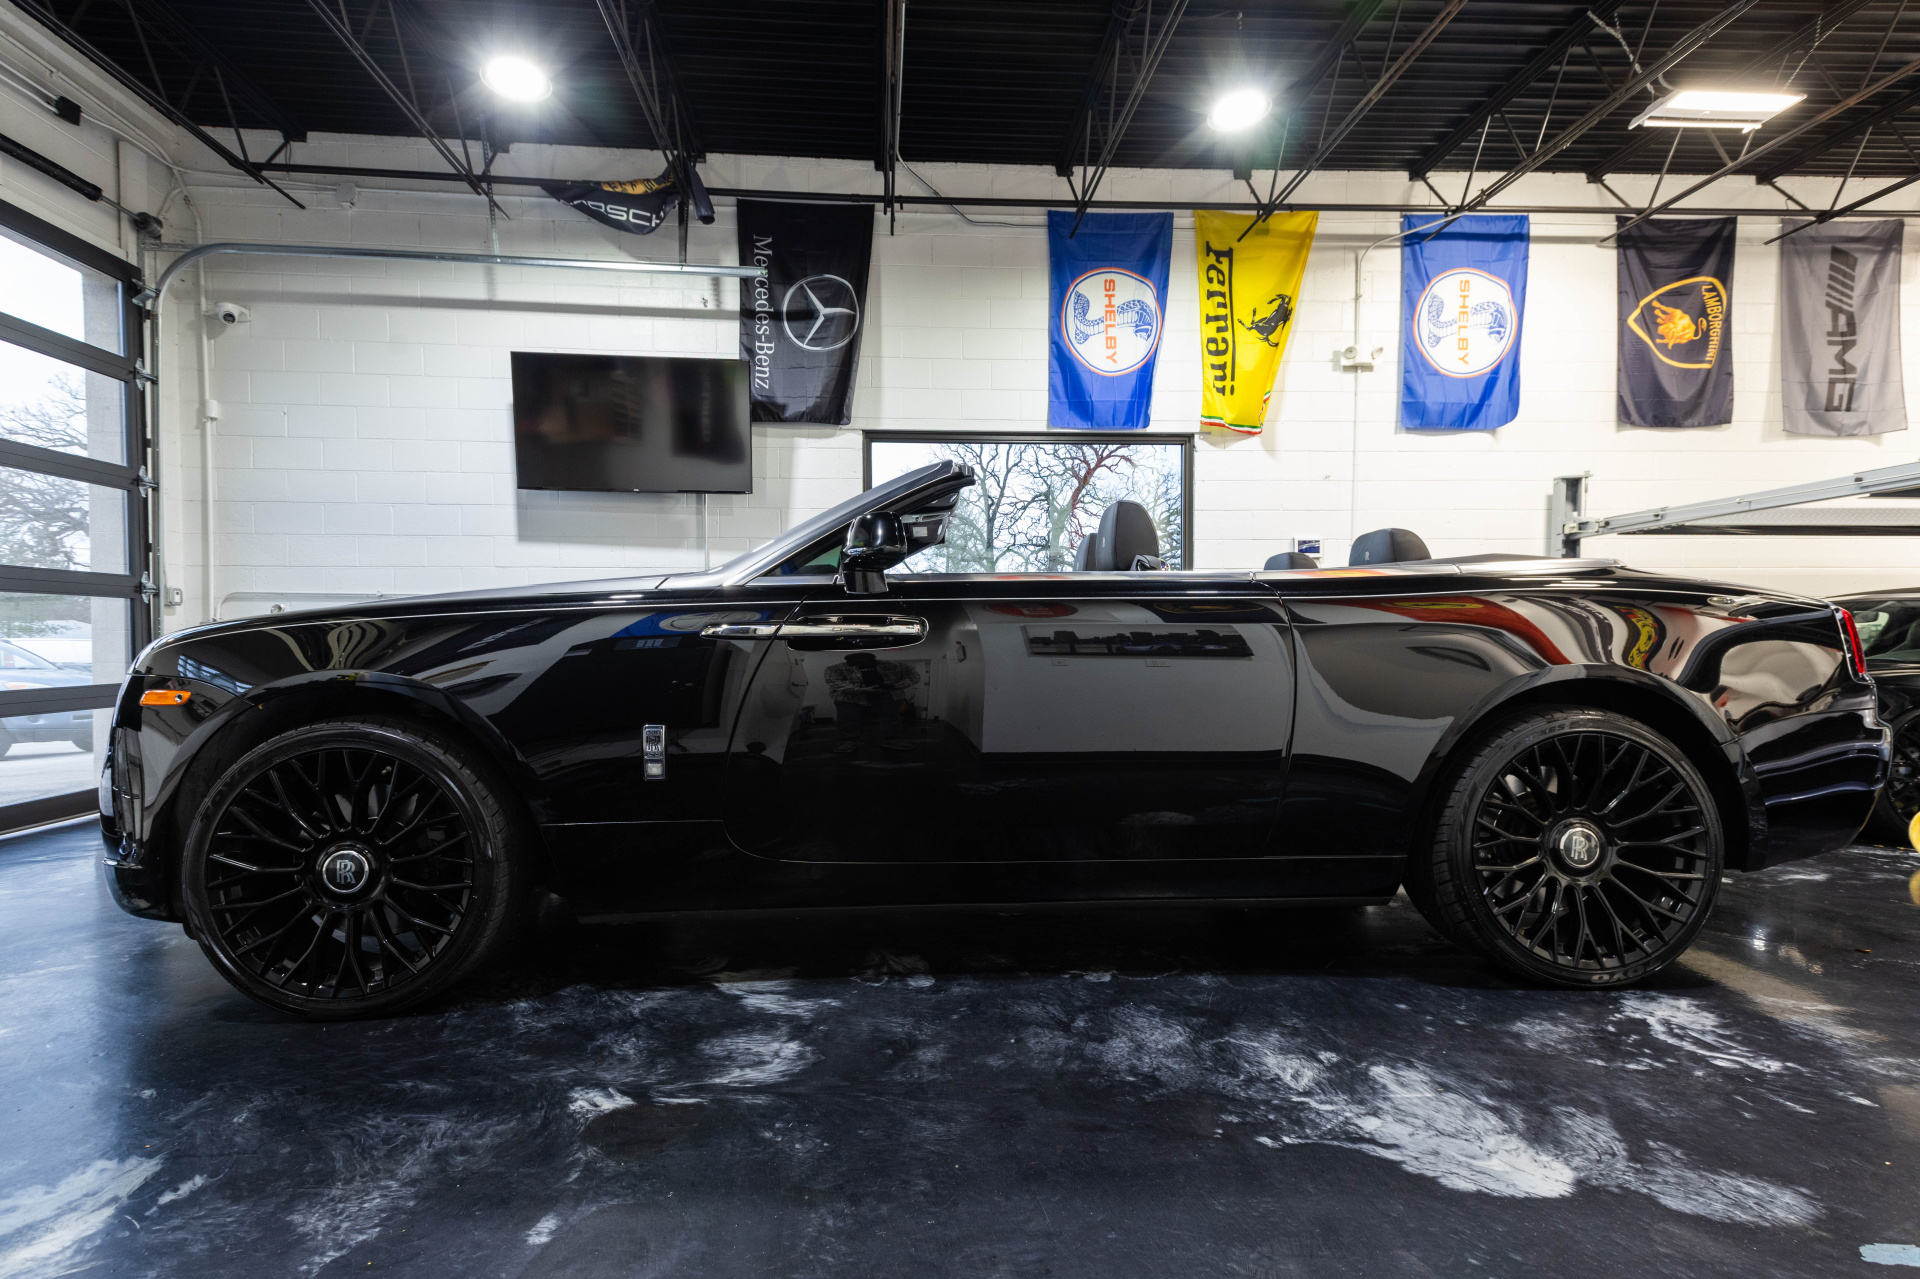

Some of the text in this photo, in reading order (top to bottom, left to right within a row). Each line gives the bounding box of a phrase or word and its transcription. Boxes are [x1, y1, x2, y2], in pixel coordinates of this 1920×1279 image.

[1104, 278, 1118, 364] SHELBY
[1205, 240, 1235, 396] Ferrari
[1457, 279, 1470, 366] SHELBY
[1701, 285, 1723, 361] LAMBORGHINI
[336, 859, 356, 885] RR
[1570, 835, 1589, 861] RR
